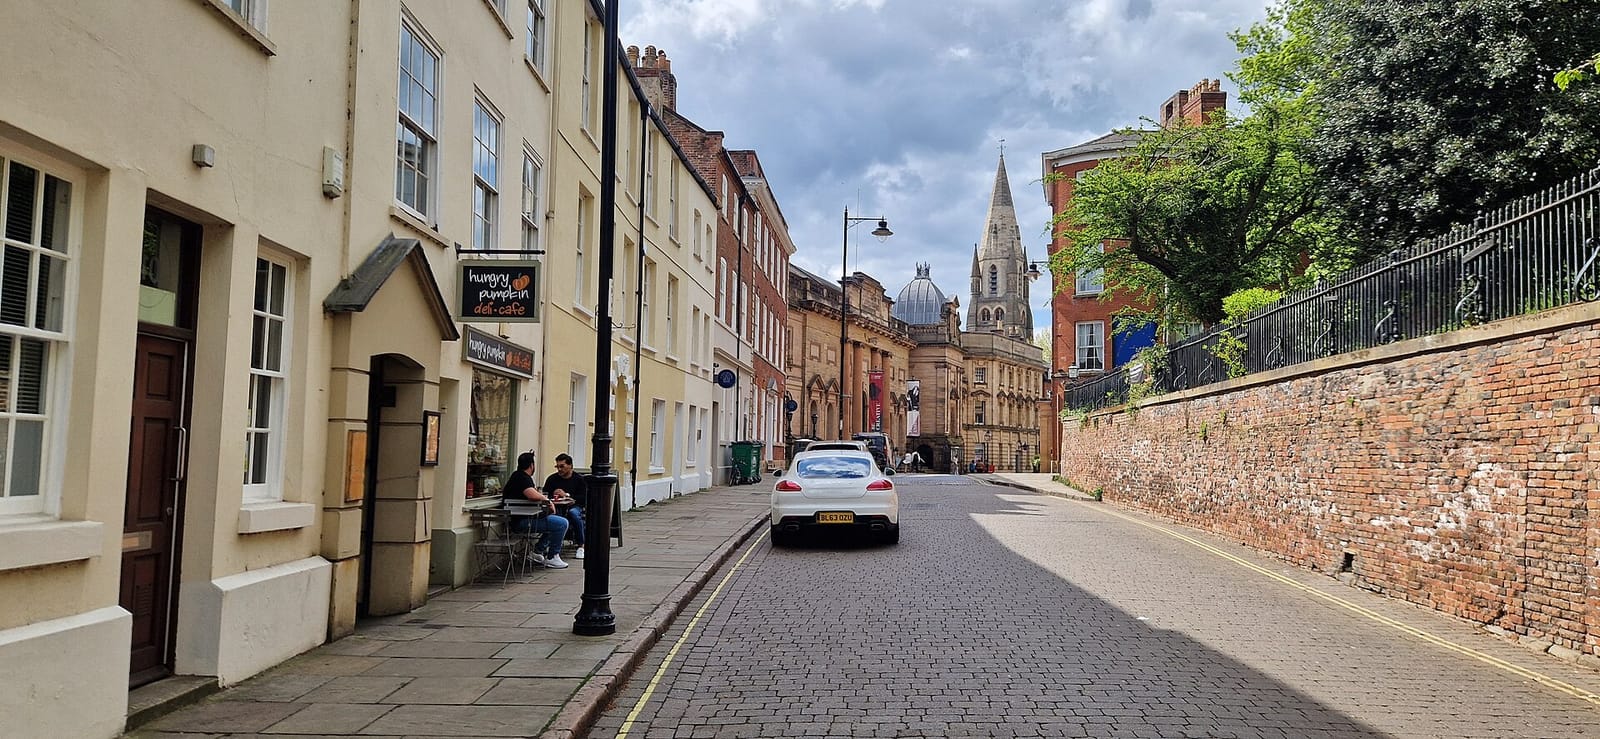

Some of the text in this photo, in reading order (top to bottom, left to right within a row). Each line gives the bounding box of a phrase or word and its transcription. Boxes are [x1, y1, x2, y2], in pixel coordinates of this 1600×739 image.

[469, 269, 509, 287] hungry
[479, 285, 529, 302] pumpkin
[469, 331, 487, 359] hungry
[486, 343, 506, 363] pumpkin
